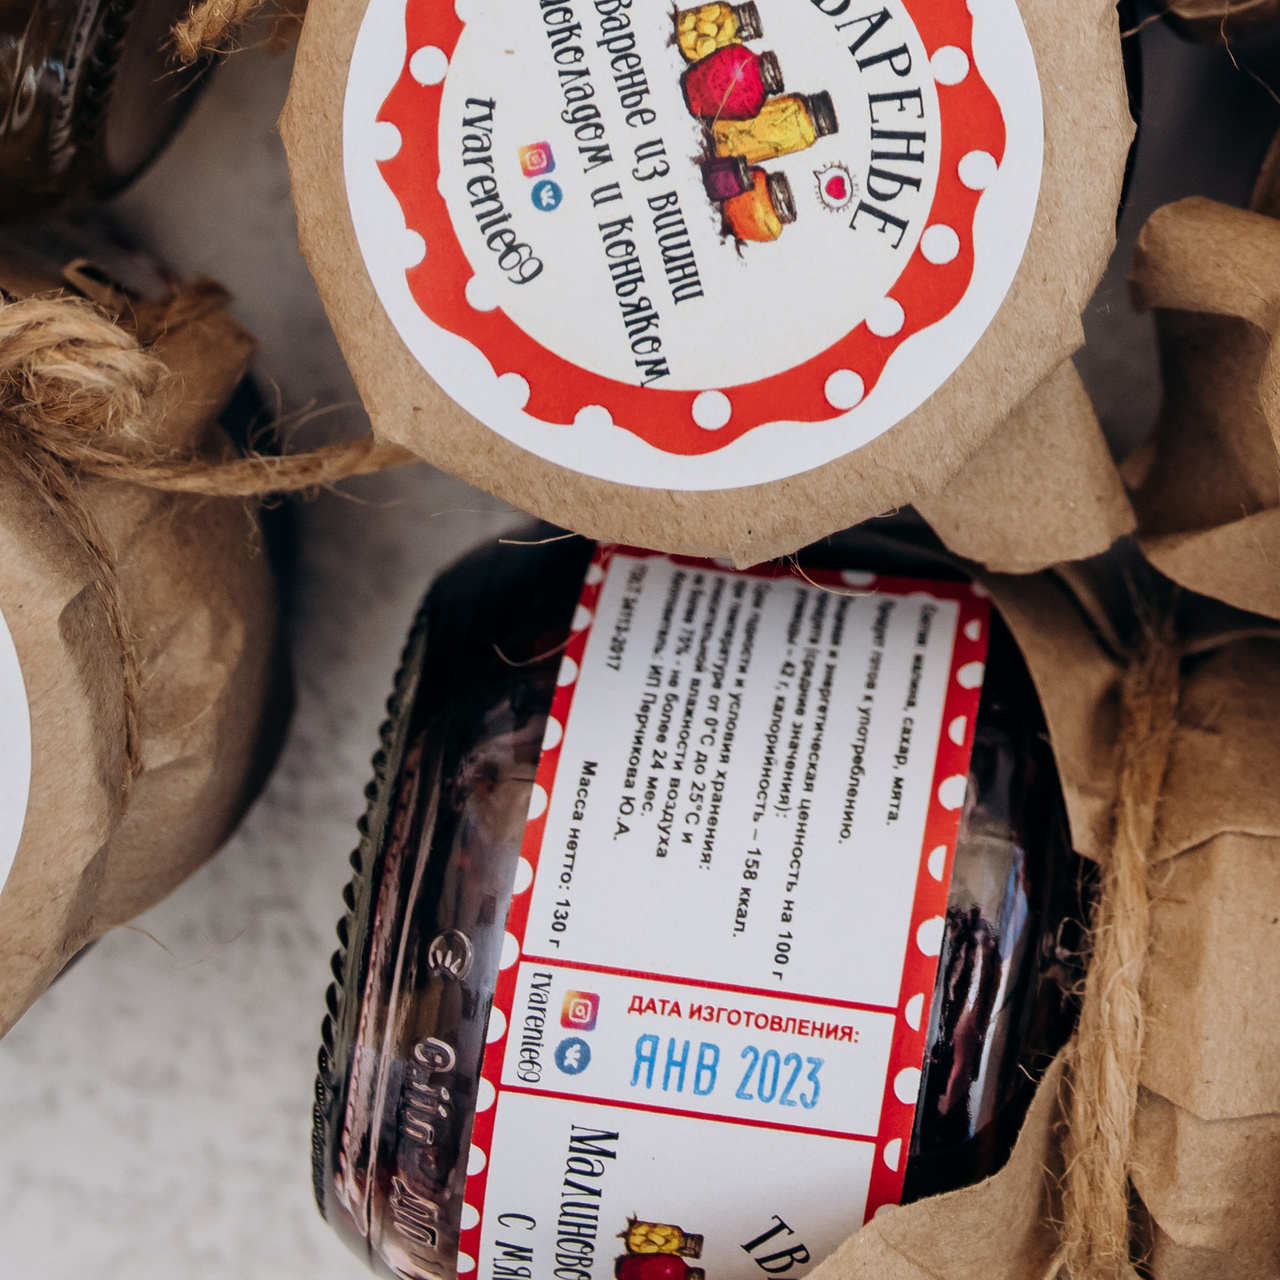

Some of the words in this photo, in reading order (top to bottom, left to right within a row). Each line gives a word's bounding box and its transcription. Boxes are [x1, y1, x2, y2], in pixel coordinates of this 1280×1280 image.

[631, 137, 671, 183] из
[461, 96, 544, 286] tvarenie69
[590, 180, 624, 209] и
[646, 189, 705, 306] вишни
[597, 214, 671, 389] коньяком
[645, 664, 664, 689] ИП
[666, 668, 682, 689] не
[733, 677, 745, 689] и
[655, 692, 680, 744] более
[706, 694, 721, 714] от
[718, 691, 743, 765] условия
[623, 691, 659, 789] Перчикова
[671, 676, 703, 783] влажности
[892, 716, 915, 770] сахар,
[649, 748, 668, 770] 24
[693, 749, 709, 776] до
[752, 694, 787, 823] калорийность
[773, 720, 804, 819] значения):
[837, 705, 873, 844] употреблению.
[571, 760, 599, 822] Масса
[640, 775, 658, 817] мес.
[885, 776, 905, 826] мята.
[612, 795, 637, 841] Ю.А.
[655, 783, 681, 859] воздуха
[680, 831, 694, 845] и
[698, 766, 728, 871] хранения:
[558, 827, 581, 891] нетто:
[742, 847, 763, 881] 158
[785, 798, 812, 893] ценность
[550, 898, 572, 933] 130
[732, 886, 752, 938] ккал.
[780, 899, 795, 924] на
[548, 938, 561, 949] г
[773, 930, 794, 966] 100
[771, 970, 784, 982] г
[516, 972, 553, 1084] tvarenie69
[626, 994, 683, 1019] ДАТА
[687, 1002, 860, 1044] ИЗГОТОВЛЕНИЯ:
[629, 1033, 721, 1097] ЯНВ
[734, 1044, 825, 1110] 2023
[496, 1212, 537, 1231] с
